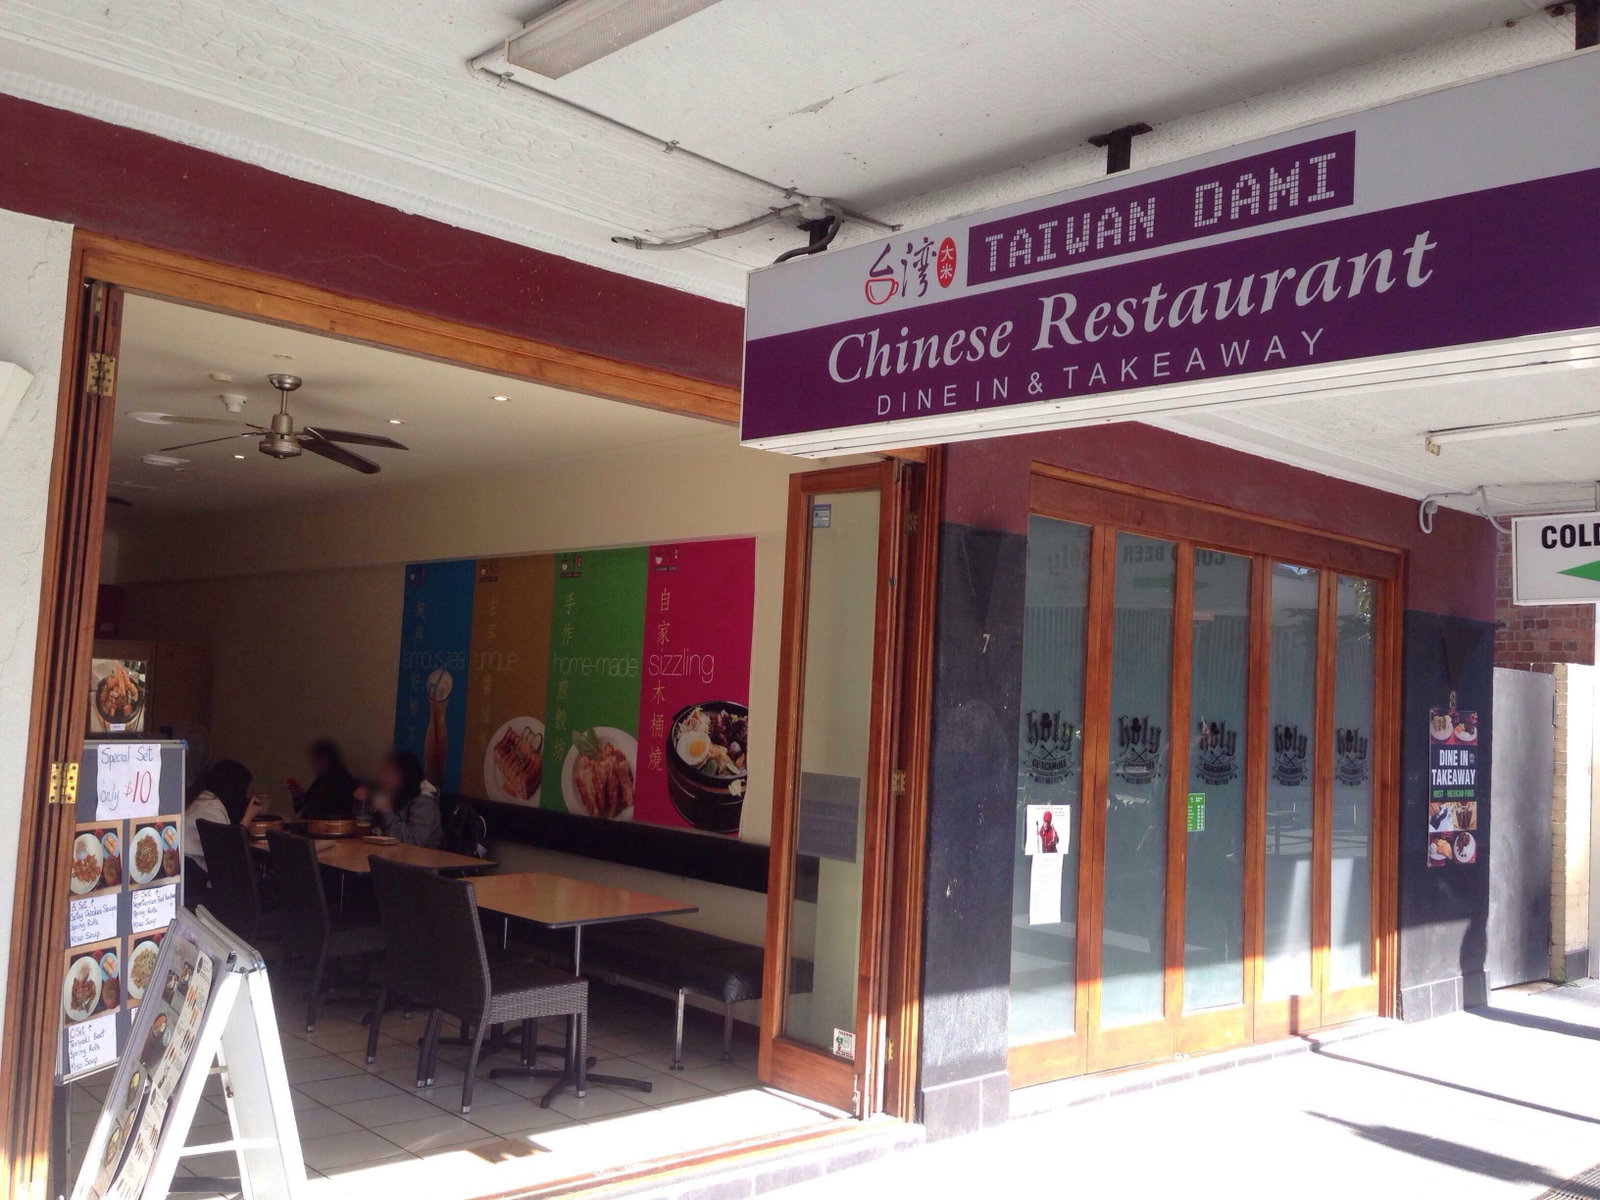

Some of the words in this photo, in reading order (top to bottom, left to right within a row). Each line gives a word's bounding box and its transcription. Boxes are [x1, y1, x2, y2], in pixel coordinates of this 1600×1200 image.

[985, 197, 1156, 272] TAIWAN
[1194, 152, 1336, 228] DAMI
[941, 244, 954, 280] 大米
[828, 320, 1014, 384] Chinese
[1032, 230, 1438, 352] Restaurant
[877, 384, 957, 416] DINE
[975, 376, 1009, 402] IN
[1027, 371, 1043, 395] &
[1063, 328, 1324, 389] TAKEAWAY
[983, 633, 990, 653] 7
[553, 652, 639, 678] home-made
[648, 648, 714, 684] sizzling
[1027, 710, 1075, 752] holy
[1118, 714, 1162, 757] holy
[101, 746, 131, 771] Special
[136, 745, 154, 762] Set
[1439, 749, 1458, 766] DINE
[1460, 750, 1469, 766] IN
[100, 783, 120, 811] only
[123, 770, 152, 803] $10
[1431, 768, 1476, 786] TAKEAWAY
[85, 931, 100, 941] Soup
